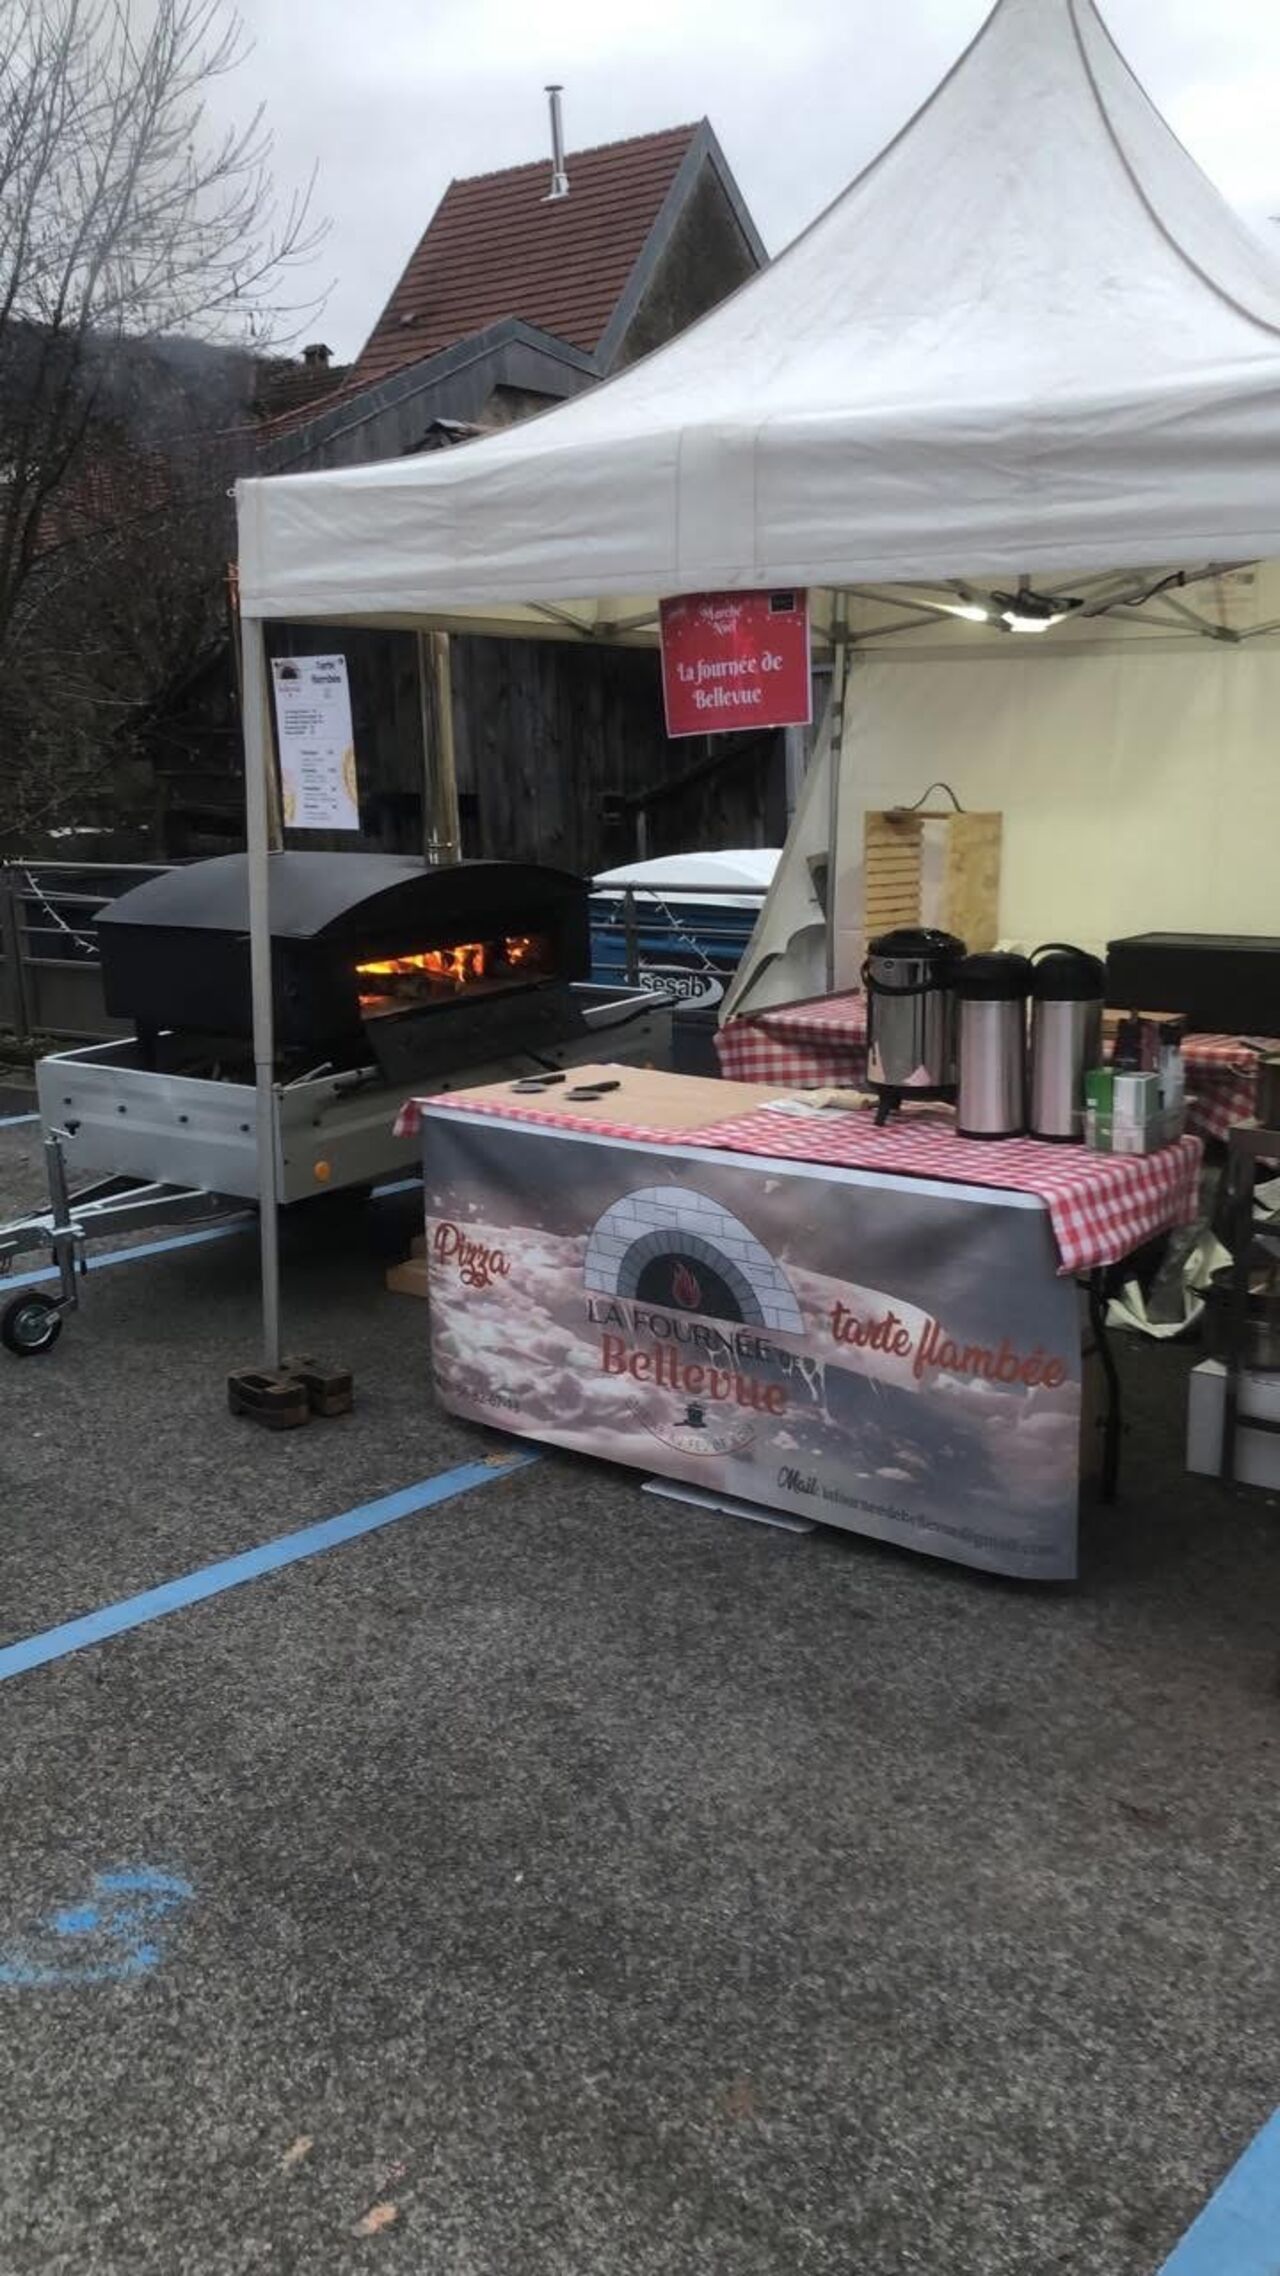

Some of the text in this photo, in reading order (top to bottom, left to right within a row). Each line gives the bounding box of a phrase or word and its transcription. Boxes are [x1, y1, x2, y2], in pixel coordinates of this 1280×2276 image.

[677, 651, 783, 686] La fournée de
[693, 687, 763, 710] Bellevue
[434, 1222, 511, 1288] Pizza
[587, 1299, 623, 1327] LA
[830, 1300, 1068, 1389] tarte flambée
[601, 1334, 789, 1416] Bellevue
